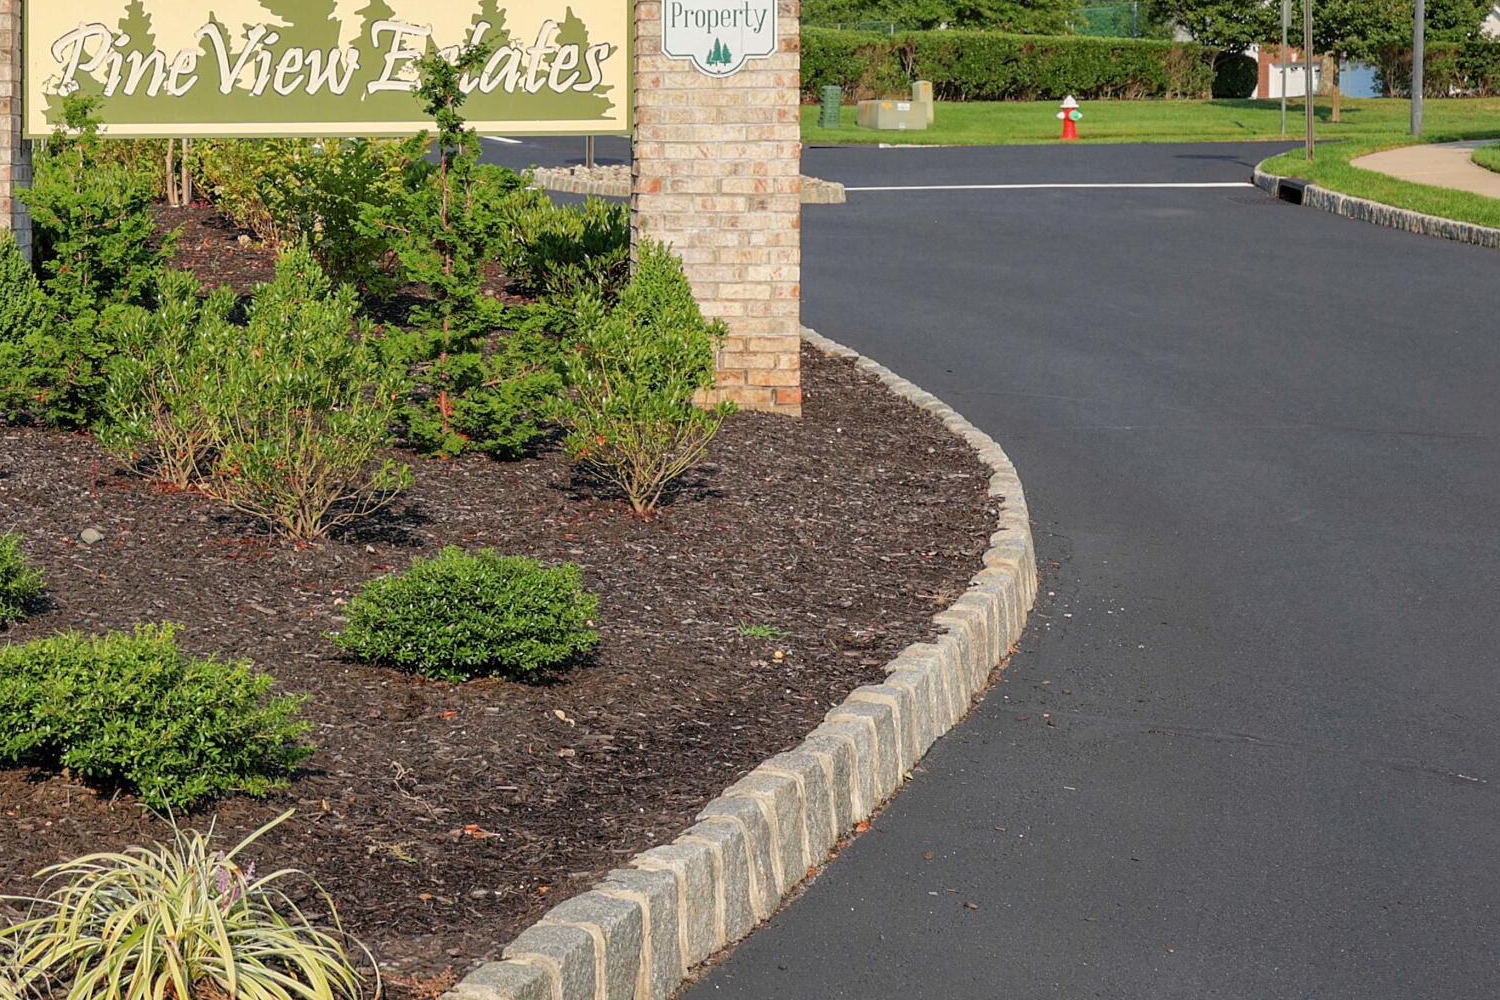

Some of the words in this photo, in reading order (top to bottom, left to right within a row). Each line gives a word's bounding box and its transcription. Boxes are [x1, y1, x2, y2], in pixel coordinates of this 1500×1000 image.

[671, 1, 768, 34] Property
[50, 21, 199, 98] Pine
[194, 21, 361, 97] View
[366, 19, 612, 95] Etates
